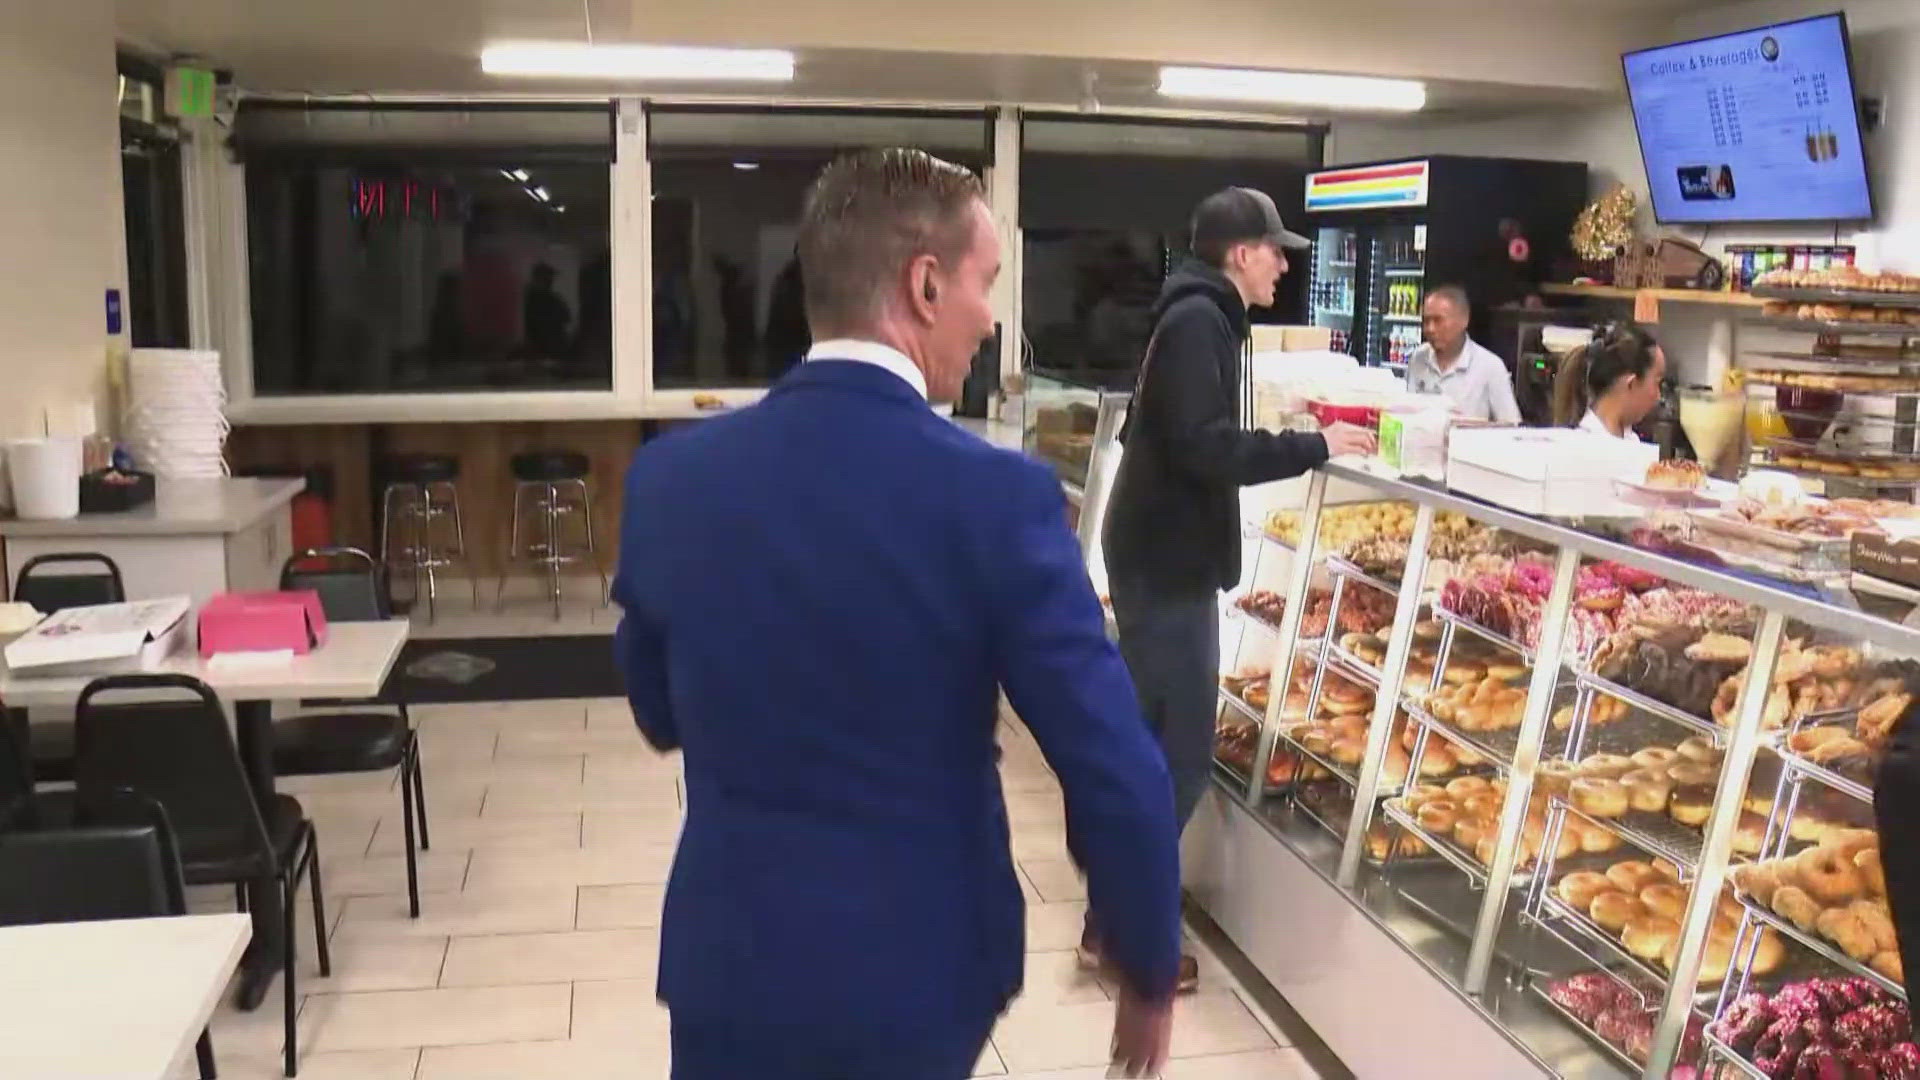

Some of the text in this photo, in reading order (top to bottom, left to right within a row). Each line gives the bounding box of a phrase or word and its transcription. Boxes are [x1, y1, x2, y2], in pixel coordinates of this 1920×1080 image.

[1650, 60, 1686, 76] Coffee
[1689, 55, 1697, 71] &
[1699, 46, 1760, 69] Beverages
